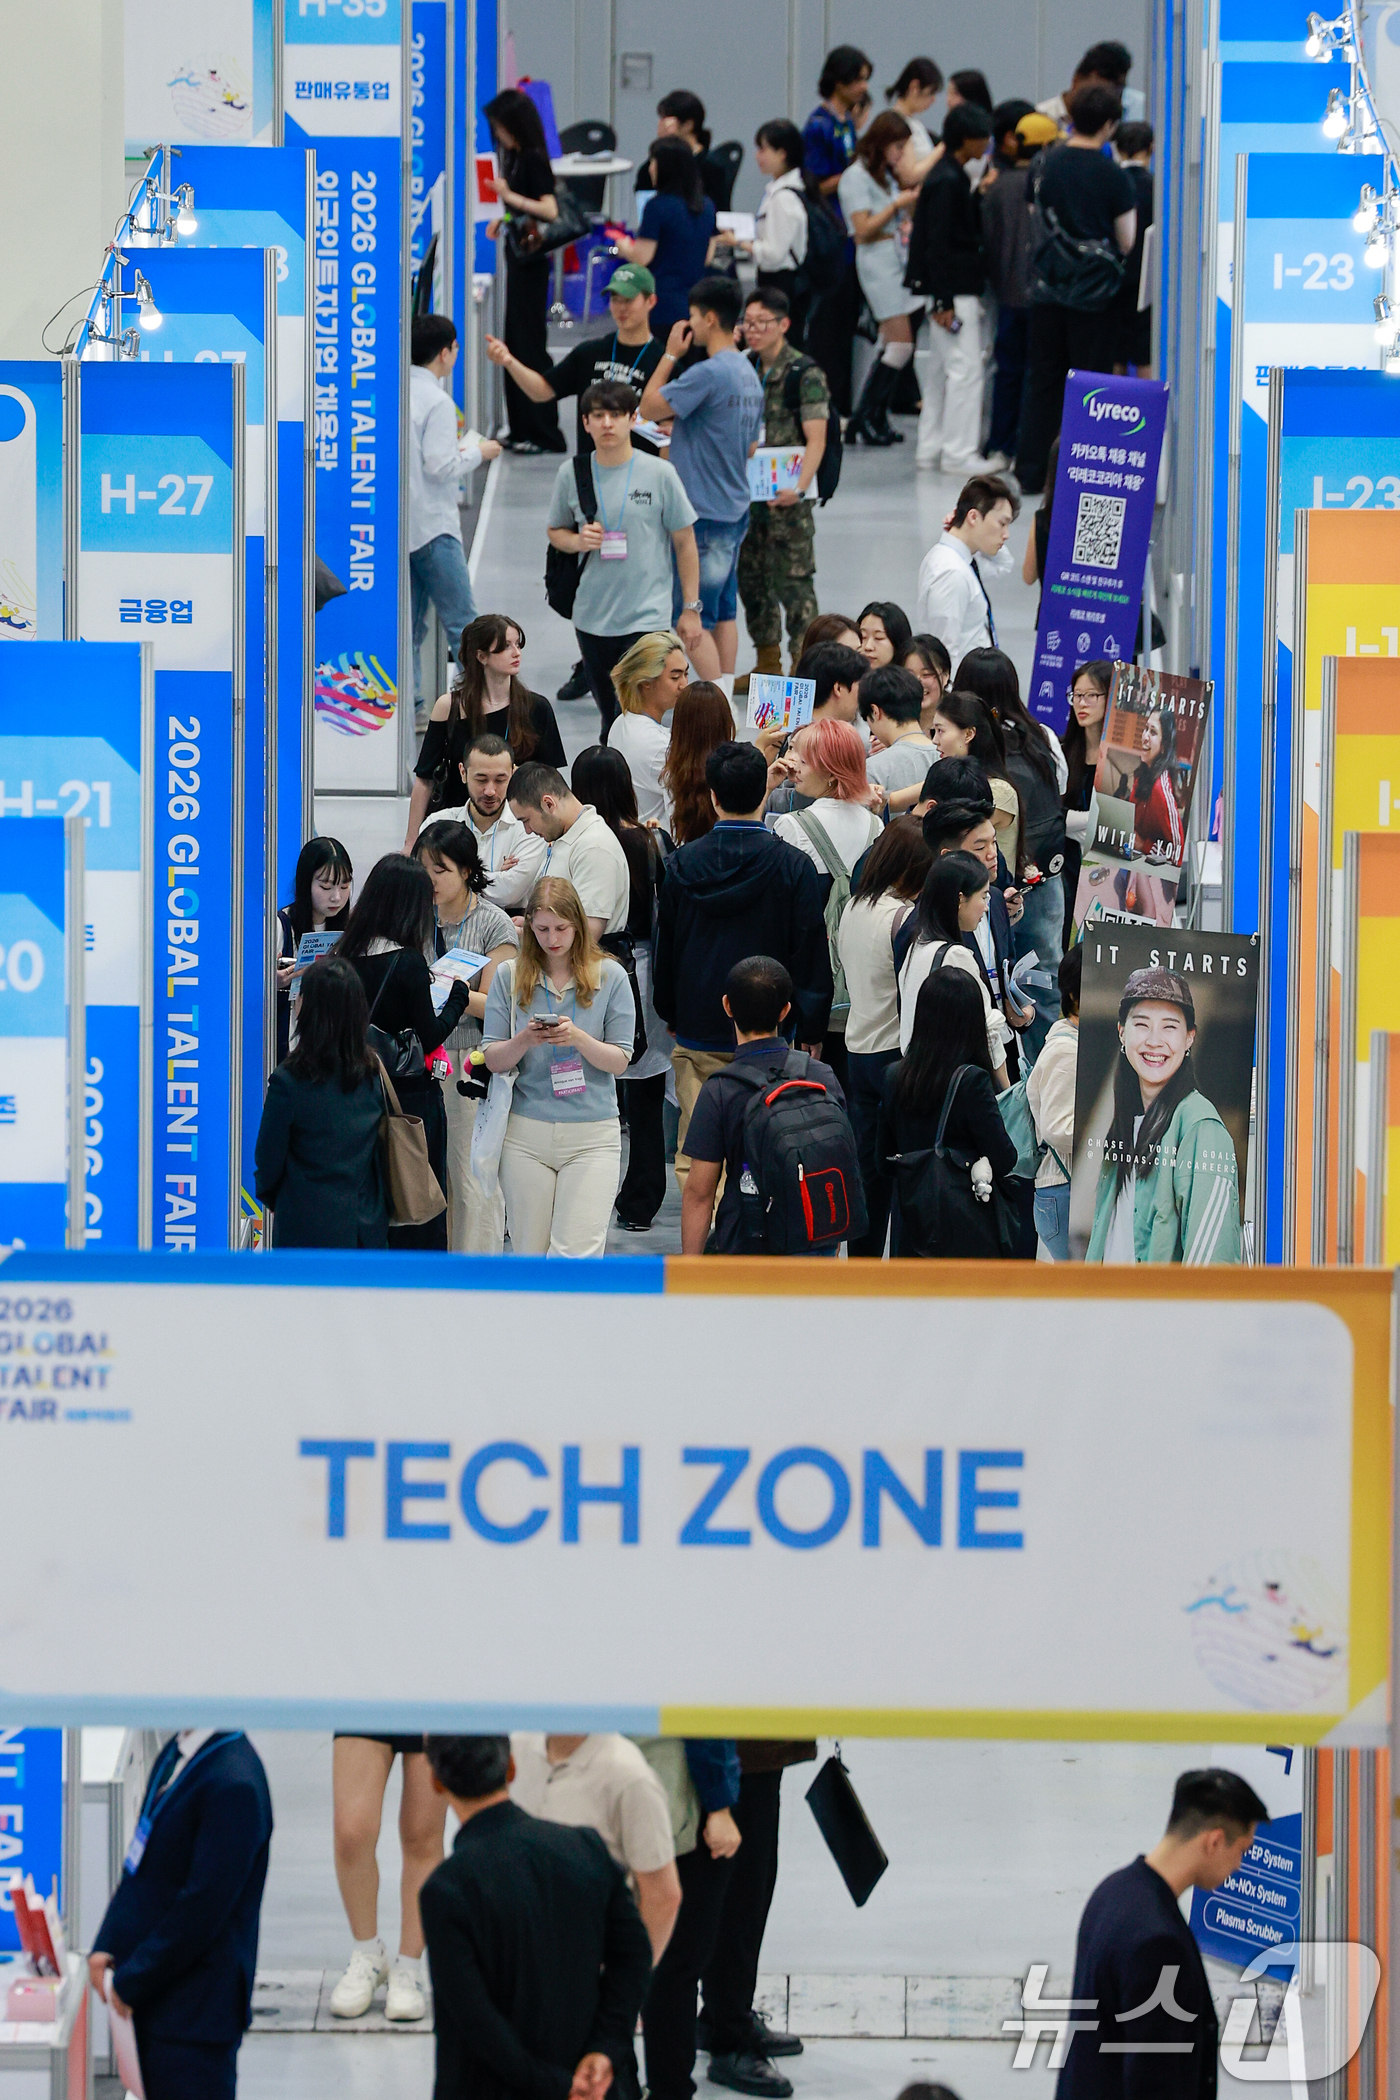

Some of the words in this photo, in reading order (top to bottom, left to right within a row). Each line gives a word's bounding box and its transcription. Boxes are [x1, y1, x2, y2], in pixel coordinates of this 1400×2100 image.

[294, 80, 390, 100] 판매유통업
[350, 170, 378, 253] 2026
[1273, 252, 1355, 290] I-23
[350, 262, 378, 389] GLOBAL
[1088, 396, 1140, 423] Lyreco
[350, 394, 378, 515] TALENT
[1070, 442, 1108, 463] 카카오톡
[1107, 447, 1128, 465] 채용
[1127, 450, 1147, 469] 채널
[101, 473, 214, 516] H-27
[348, 524, 376, 591] FAIR
[119, 598, 193, 625] 금융업
[1118, 683, 1134, 703] IT
[1148, 690, 1206, 720] STARTS
[167, 715, 201, 821] 2026
[1097, 825, 1137, 850] WITH
[1155, 839, 1183, 863] YOU
[166, 833, 200, 998] GLOBAL
[1095, 944, 1119, 965] IT
[1149, 949, 1248, 977] STARTS
[166, 1004, 200, 1162] TALENT
[1087, 1138, 1124, 1150] CHASE
[1148, 1143, 1178, 1156] YOUR
[1202, 1149, 1237, 1162] GOALS
[1104, 1152, 1237, 1174] ADIDAS.COM/CAREERS
[298, 1438, 642, 1546] TECH
[678, 1445, 1026, 1550] ZONE
[1262, 1848, 1294, 1873] System
[1223, 1875, 1257, 1898] De-NOx
[1256, 1884, 1288, 1908] System
[1215, 1908, 1246, 1931] Plasma
[1245, 1918, 1284, 1944] Scrubber
